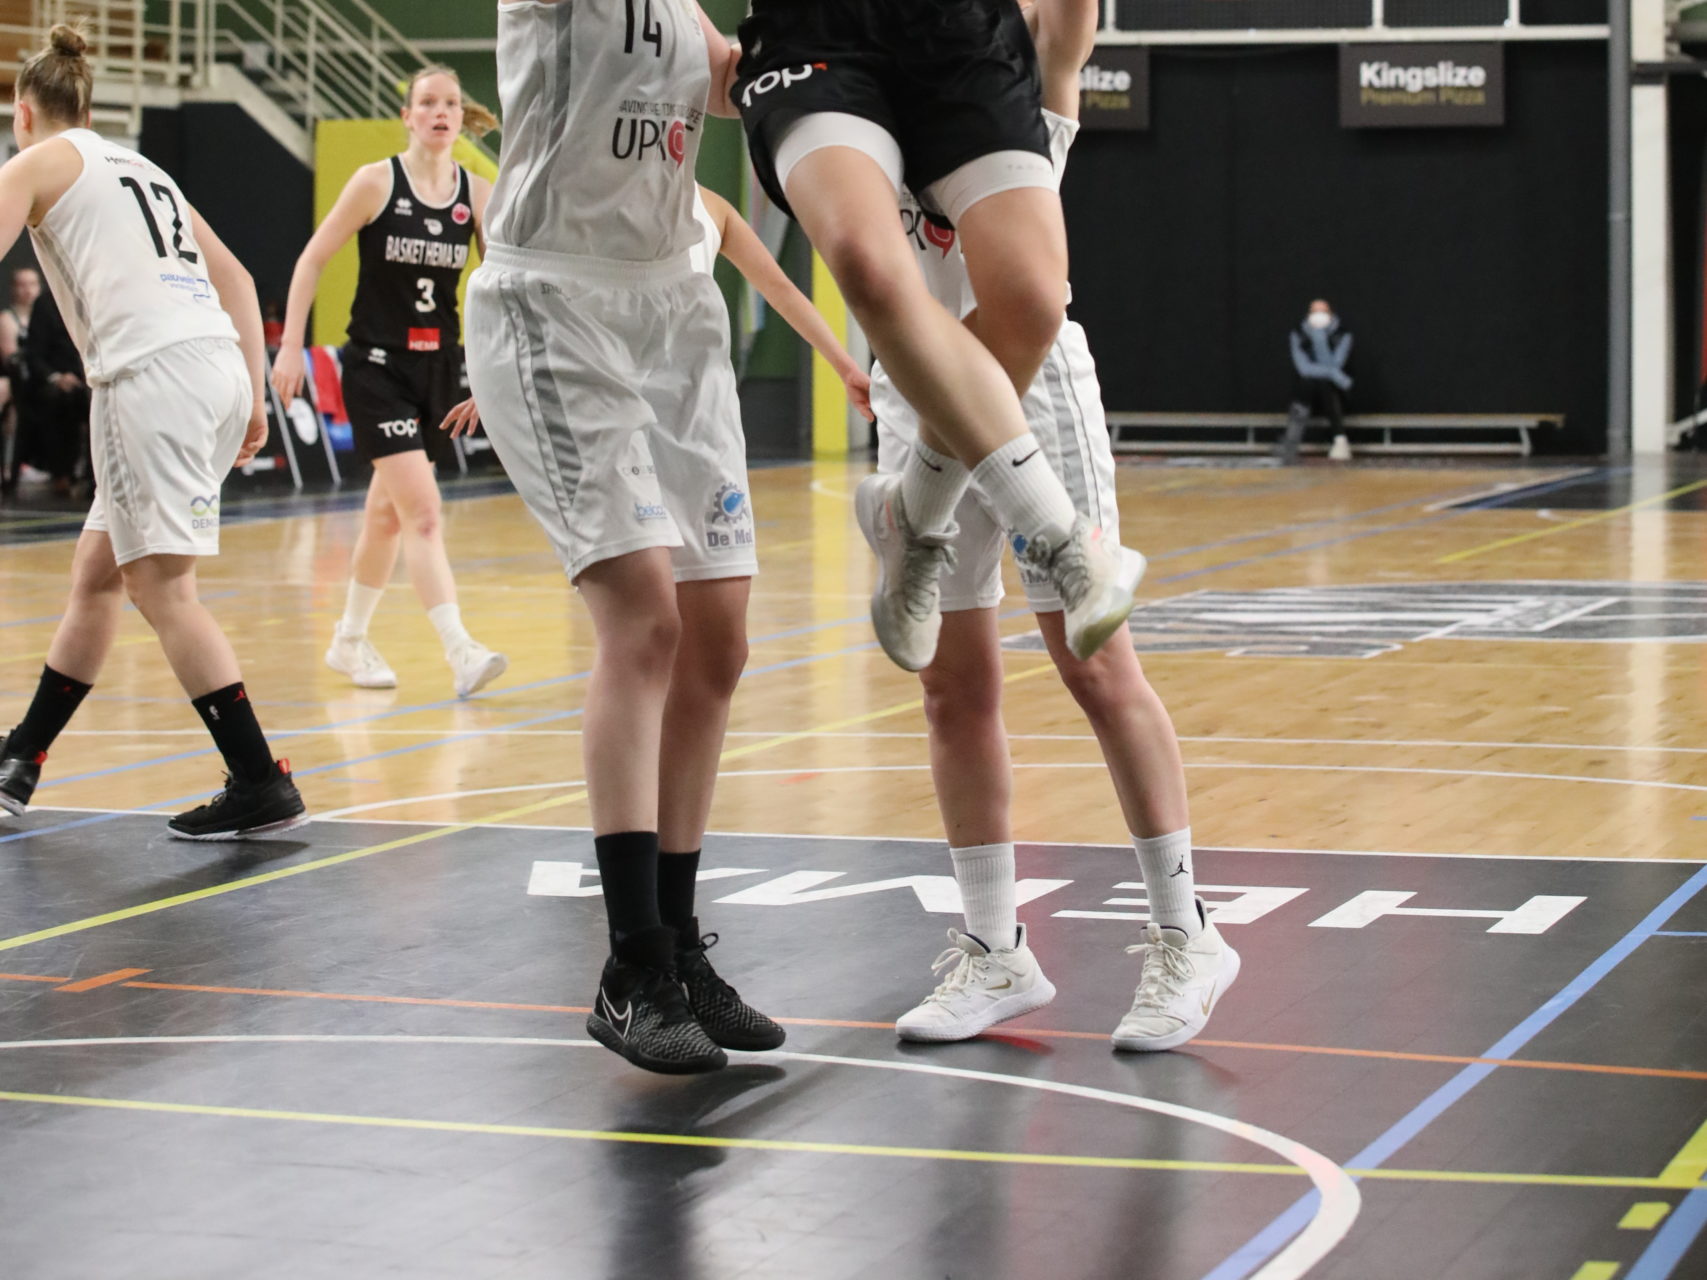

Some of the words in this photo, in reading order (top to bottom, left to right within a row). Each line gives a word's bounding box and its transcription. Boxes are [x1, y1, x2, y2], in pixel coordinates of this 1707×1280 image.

[1360, 61, 1487, 93] Kingslize
[119, 176, 198, 264] 12
[385, 235, 426, 265] BASKET
[415, 277, 437, 313] 3
